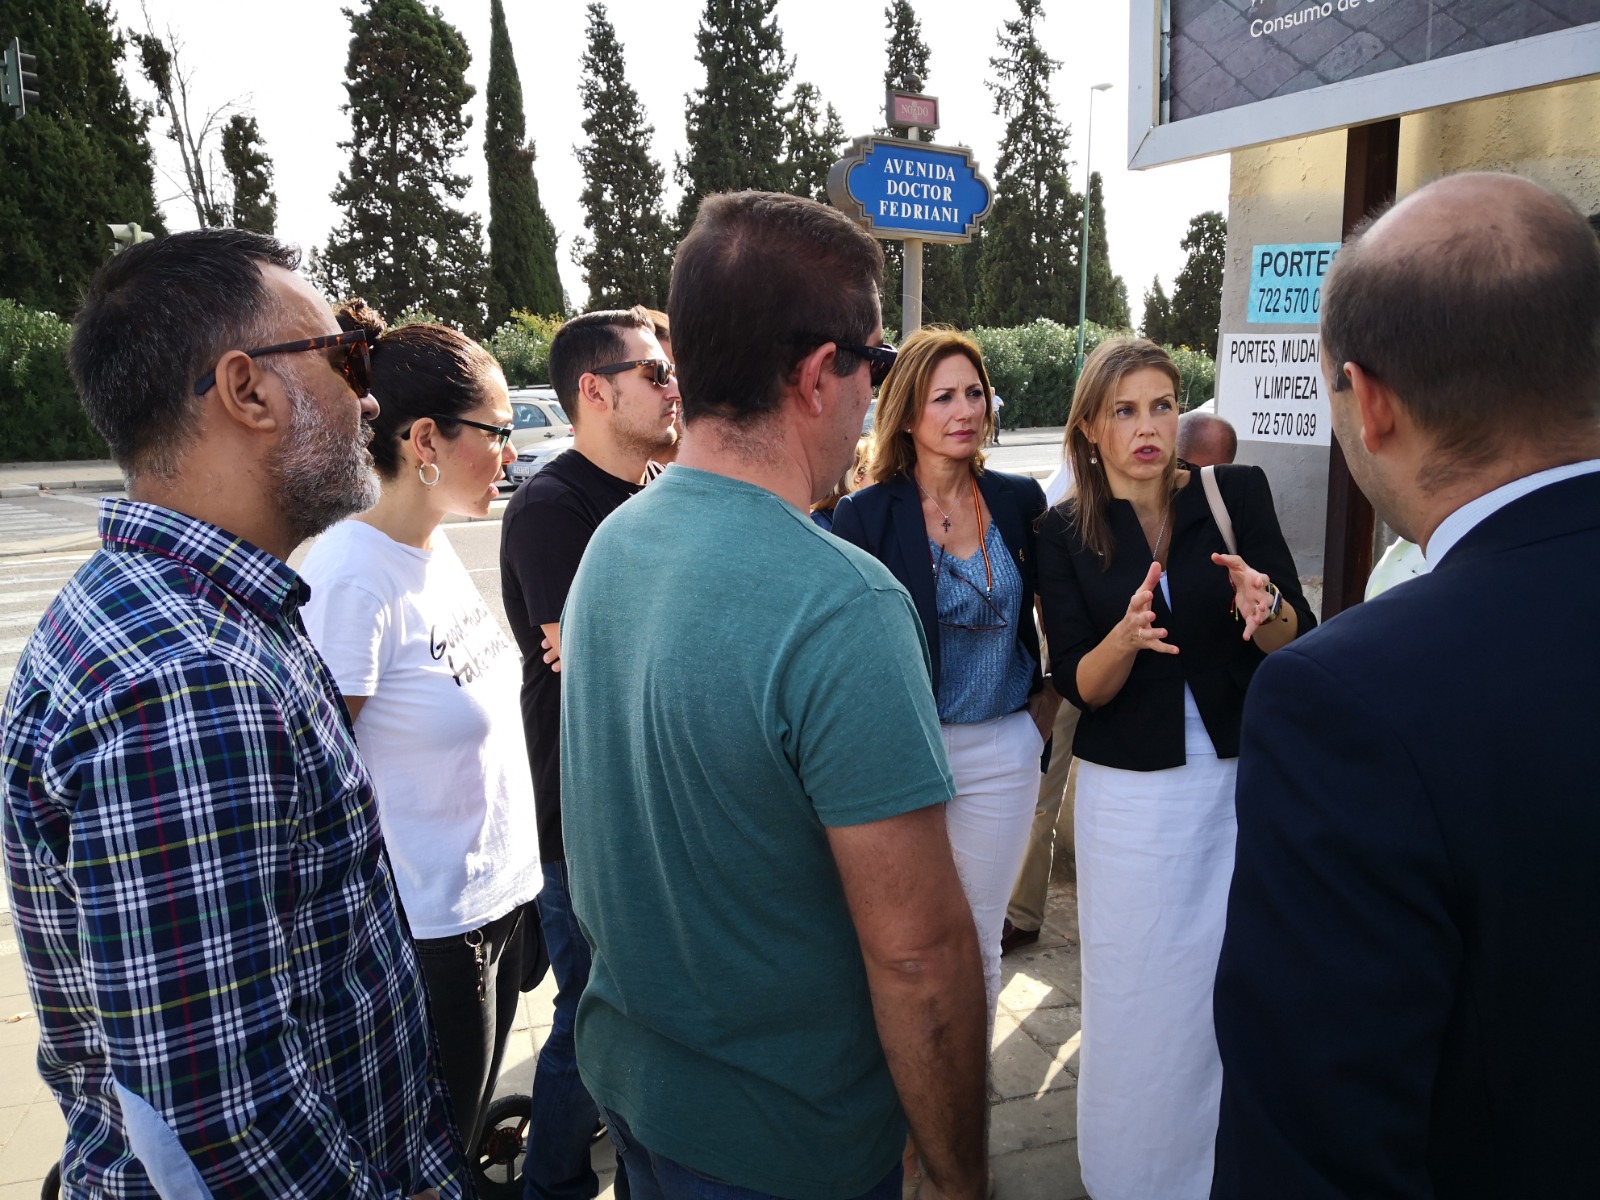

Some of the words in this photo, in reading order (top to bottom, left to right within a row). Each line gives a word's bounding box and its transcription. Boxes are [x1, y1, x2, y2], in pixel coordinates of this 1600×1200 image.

[1250, 2, 1332, 38] Consumo
[884, 158, 956, 182] AVENIDA
[886, 180, 953, 202] DOCTOR
[879, 200, 959, 223] FEDRIANI
[1258, 288, 1280, 313] 722
[1284, 288, 1309, 313] 570
[1230, 340, 1278, 367] PORTES,
[1254, 376, 1262, 399] Y
[1264, 376, 1318, 400] LIMPIEZA
[1251, 412, 1270, 435] 722
[1272, 412, 1293, 436] 570
[1296, 413, 1317, 437] 039
